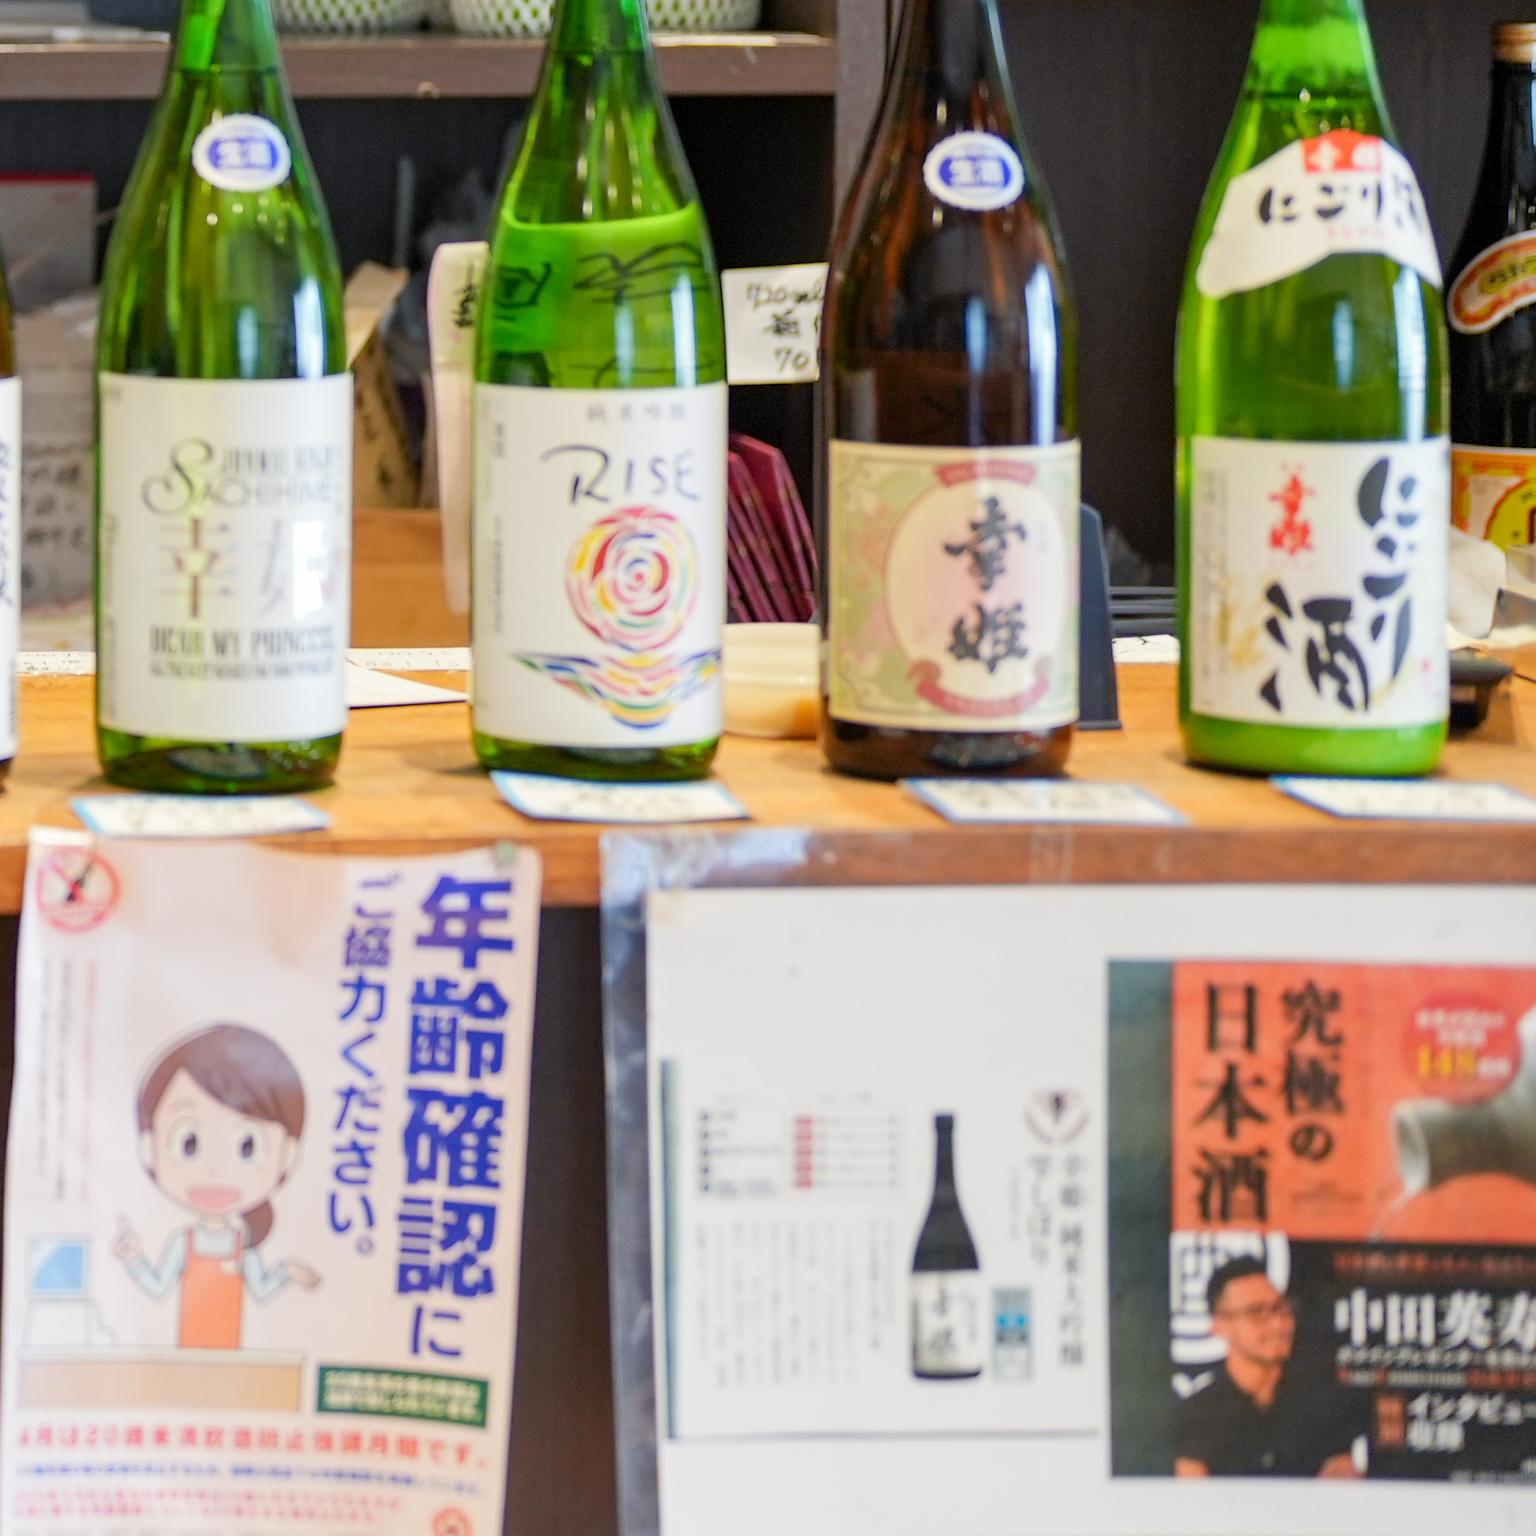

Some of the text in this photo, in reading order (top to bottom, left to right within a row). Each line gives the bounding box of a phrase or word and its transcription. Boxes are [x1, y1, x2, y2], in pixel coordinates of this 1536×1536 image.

[539, 443, 702, 505] RISE
[944, 494, 1029, 674] 幸姫
[327, 871, 406, 1257] ご協力ください。
[398, 872, 517, 1359] 年齢確認に
[1193, 980, 1271, 1225] 日本酒
[1281, 978, 1344, 1163] 究極の
